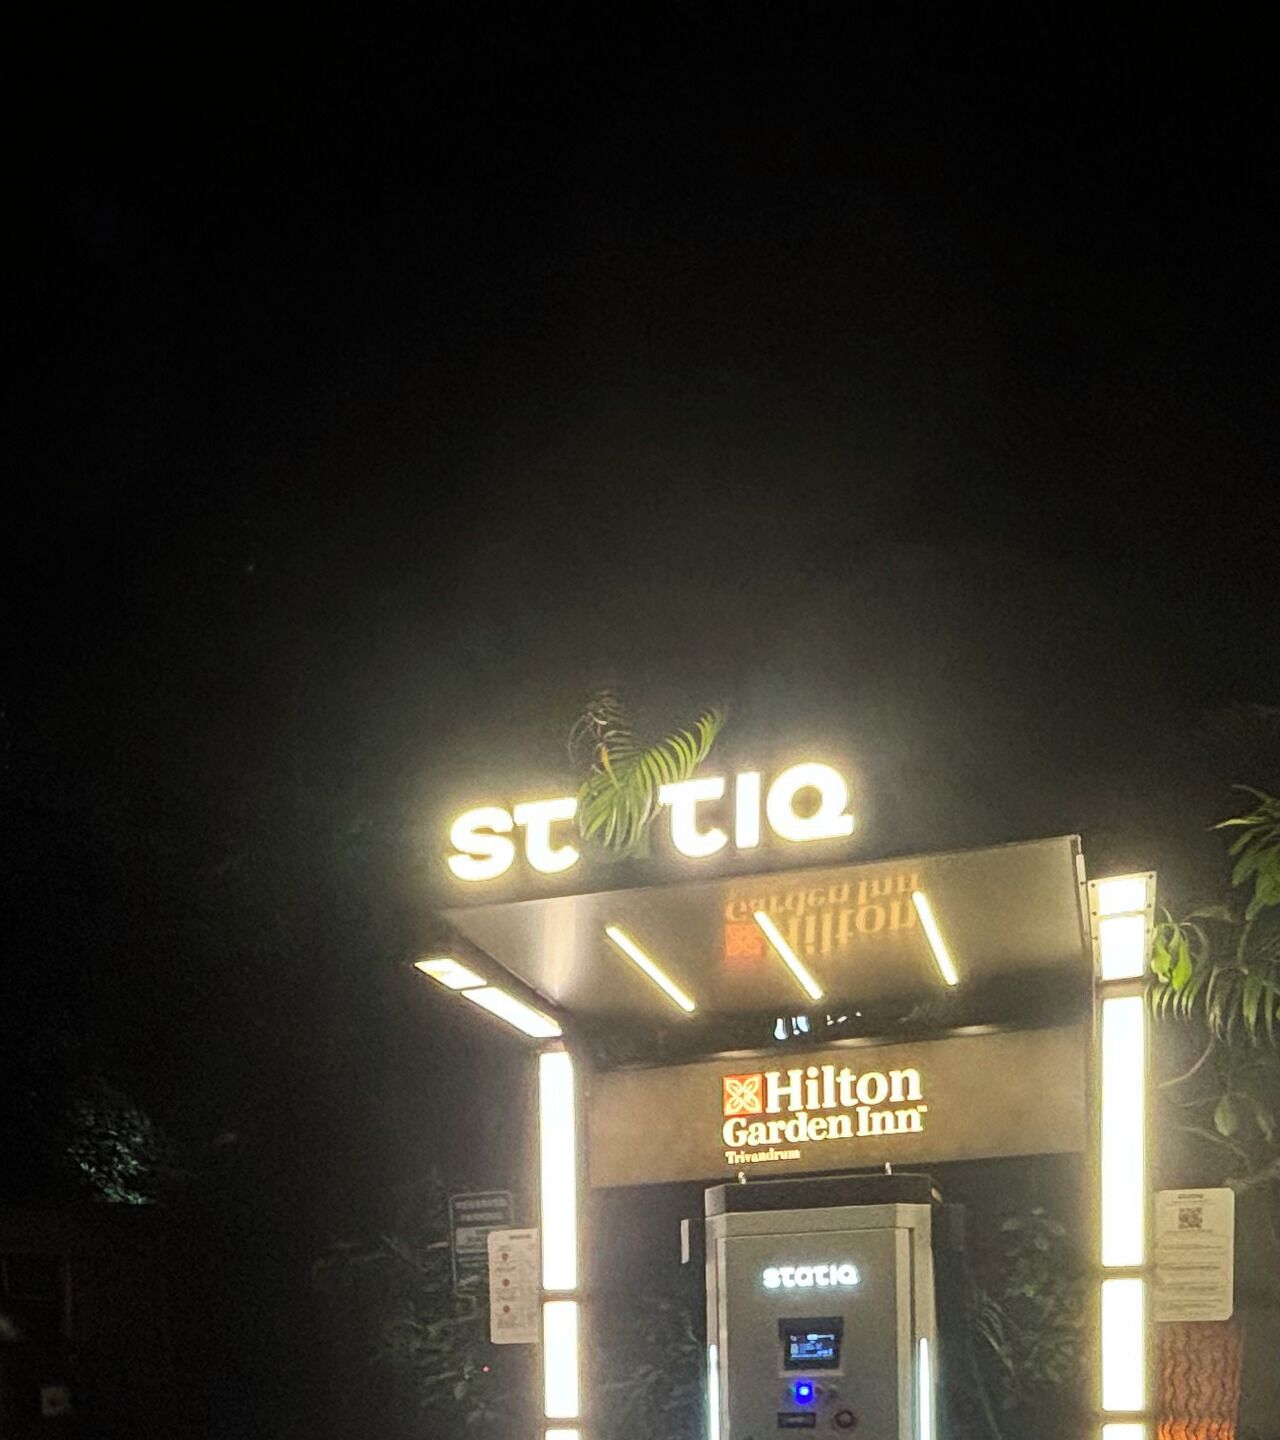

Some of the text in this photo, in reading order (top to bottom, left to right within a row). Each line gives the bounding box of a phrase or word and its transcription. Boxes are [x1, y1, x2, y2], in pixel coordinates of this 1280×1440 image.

[764, 1064, 924, 1114] Hilton
[722, 1112, 853, 1148] Garden
[725, 1148, 801, 1165] Trivandrum
